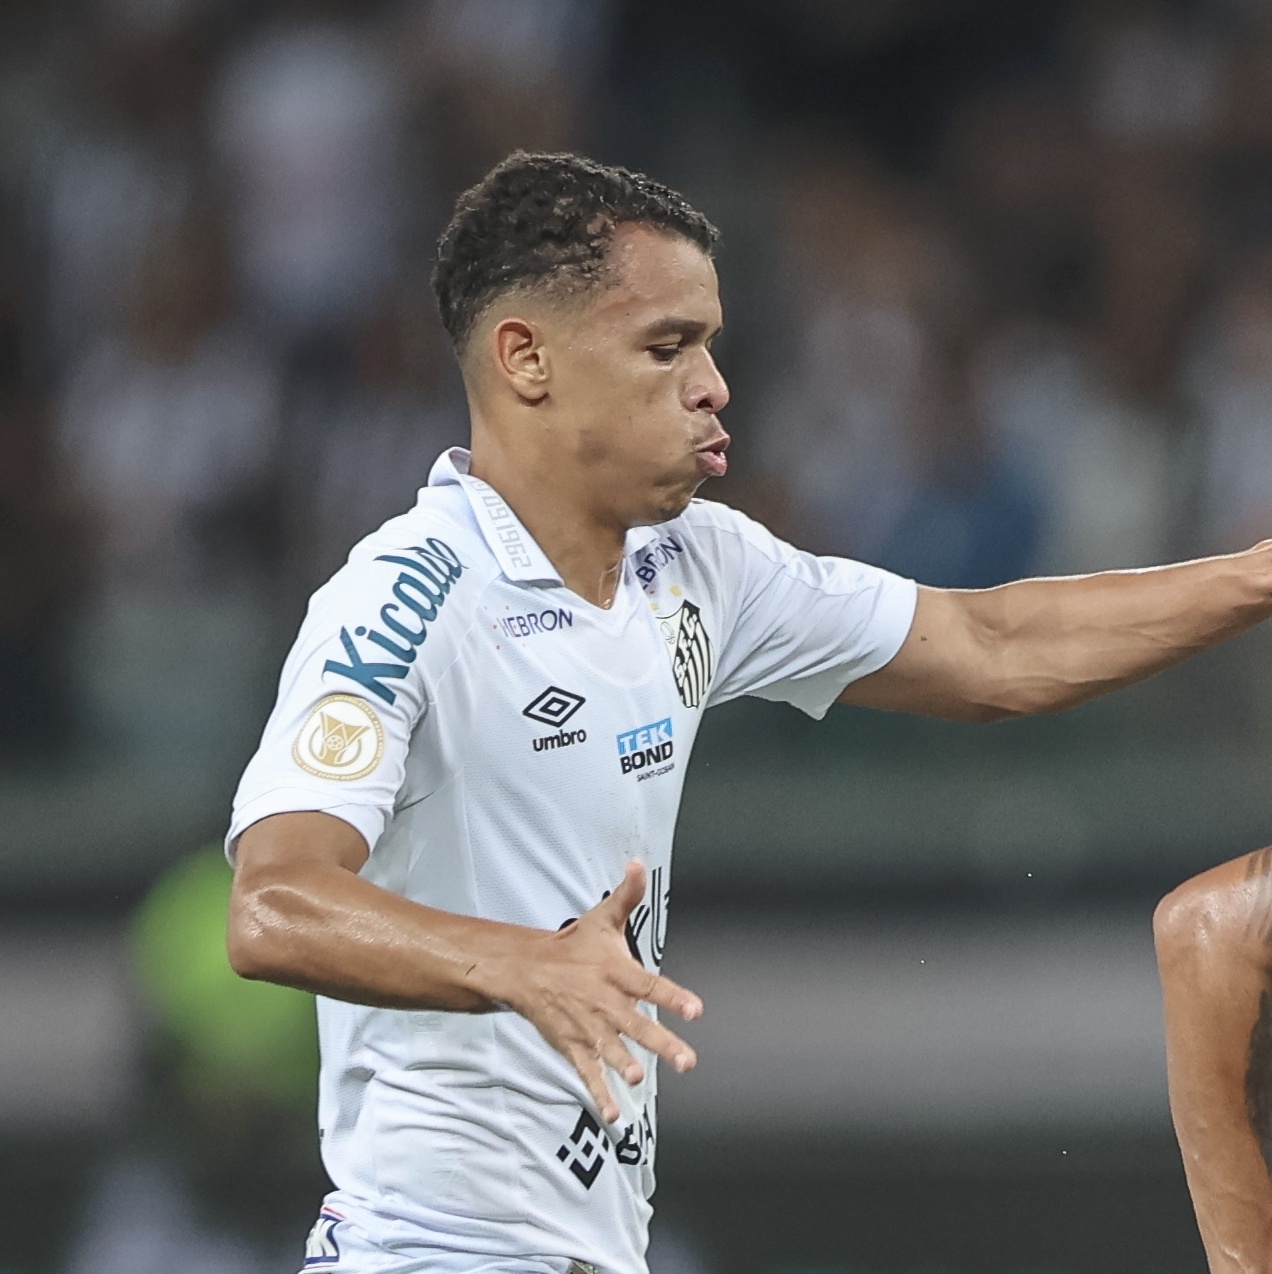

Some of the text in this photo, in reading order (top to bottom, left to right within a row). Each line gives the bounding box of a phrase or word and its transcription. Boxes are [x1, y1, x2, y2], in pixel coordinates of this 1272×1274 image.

[321, 537, 469, 706] Kicaldo
[532, 728, 587, 752] umbro
[618, 722, 670, 755] TEK
[620, 741, 674, 775] BOND
